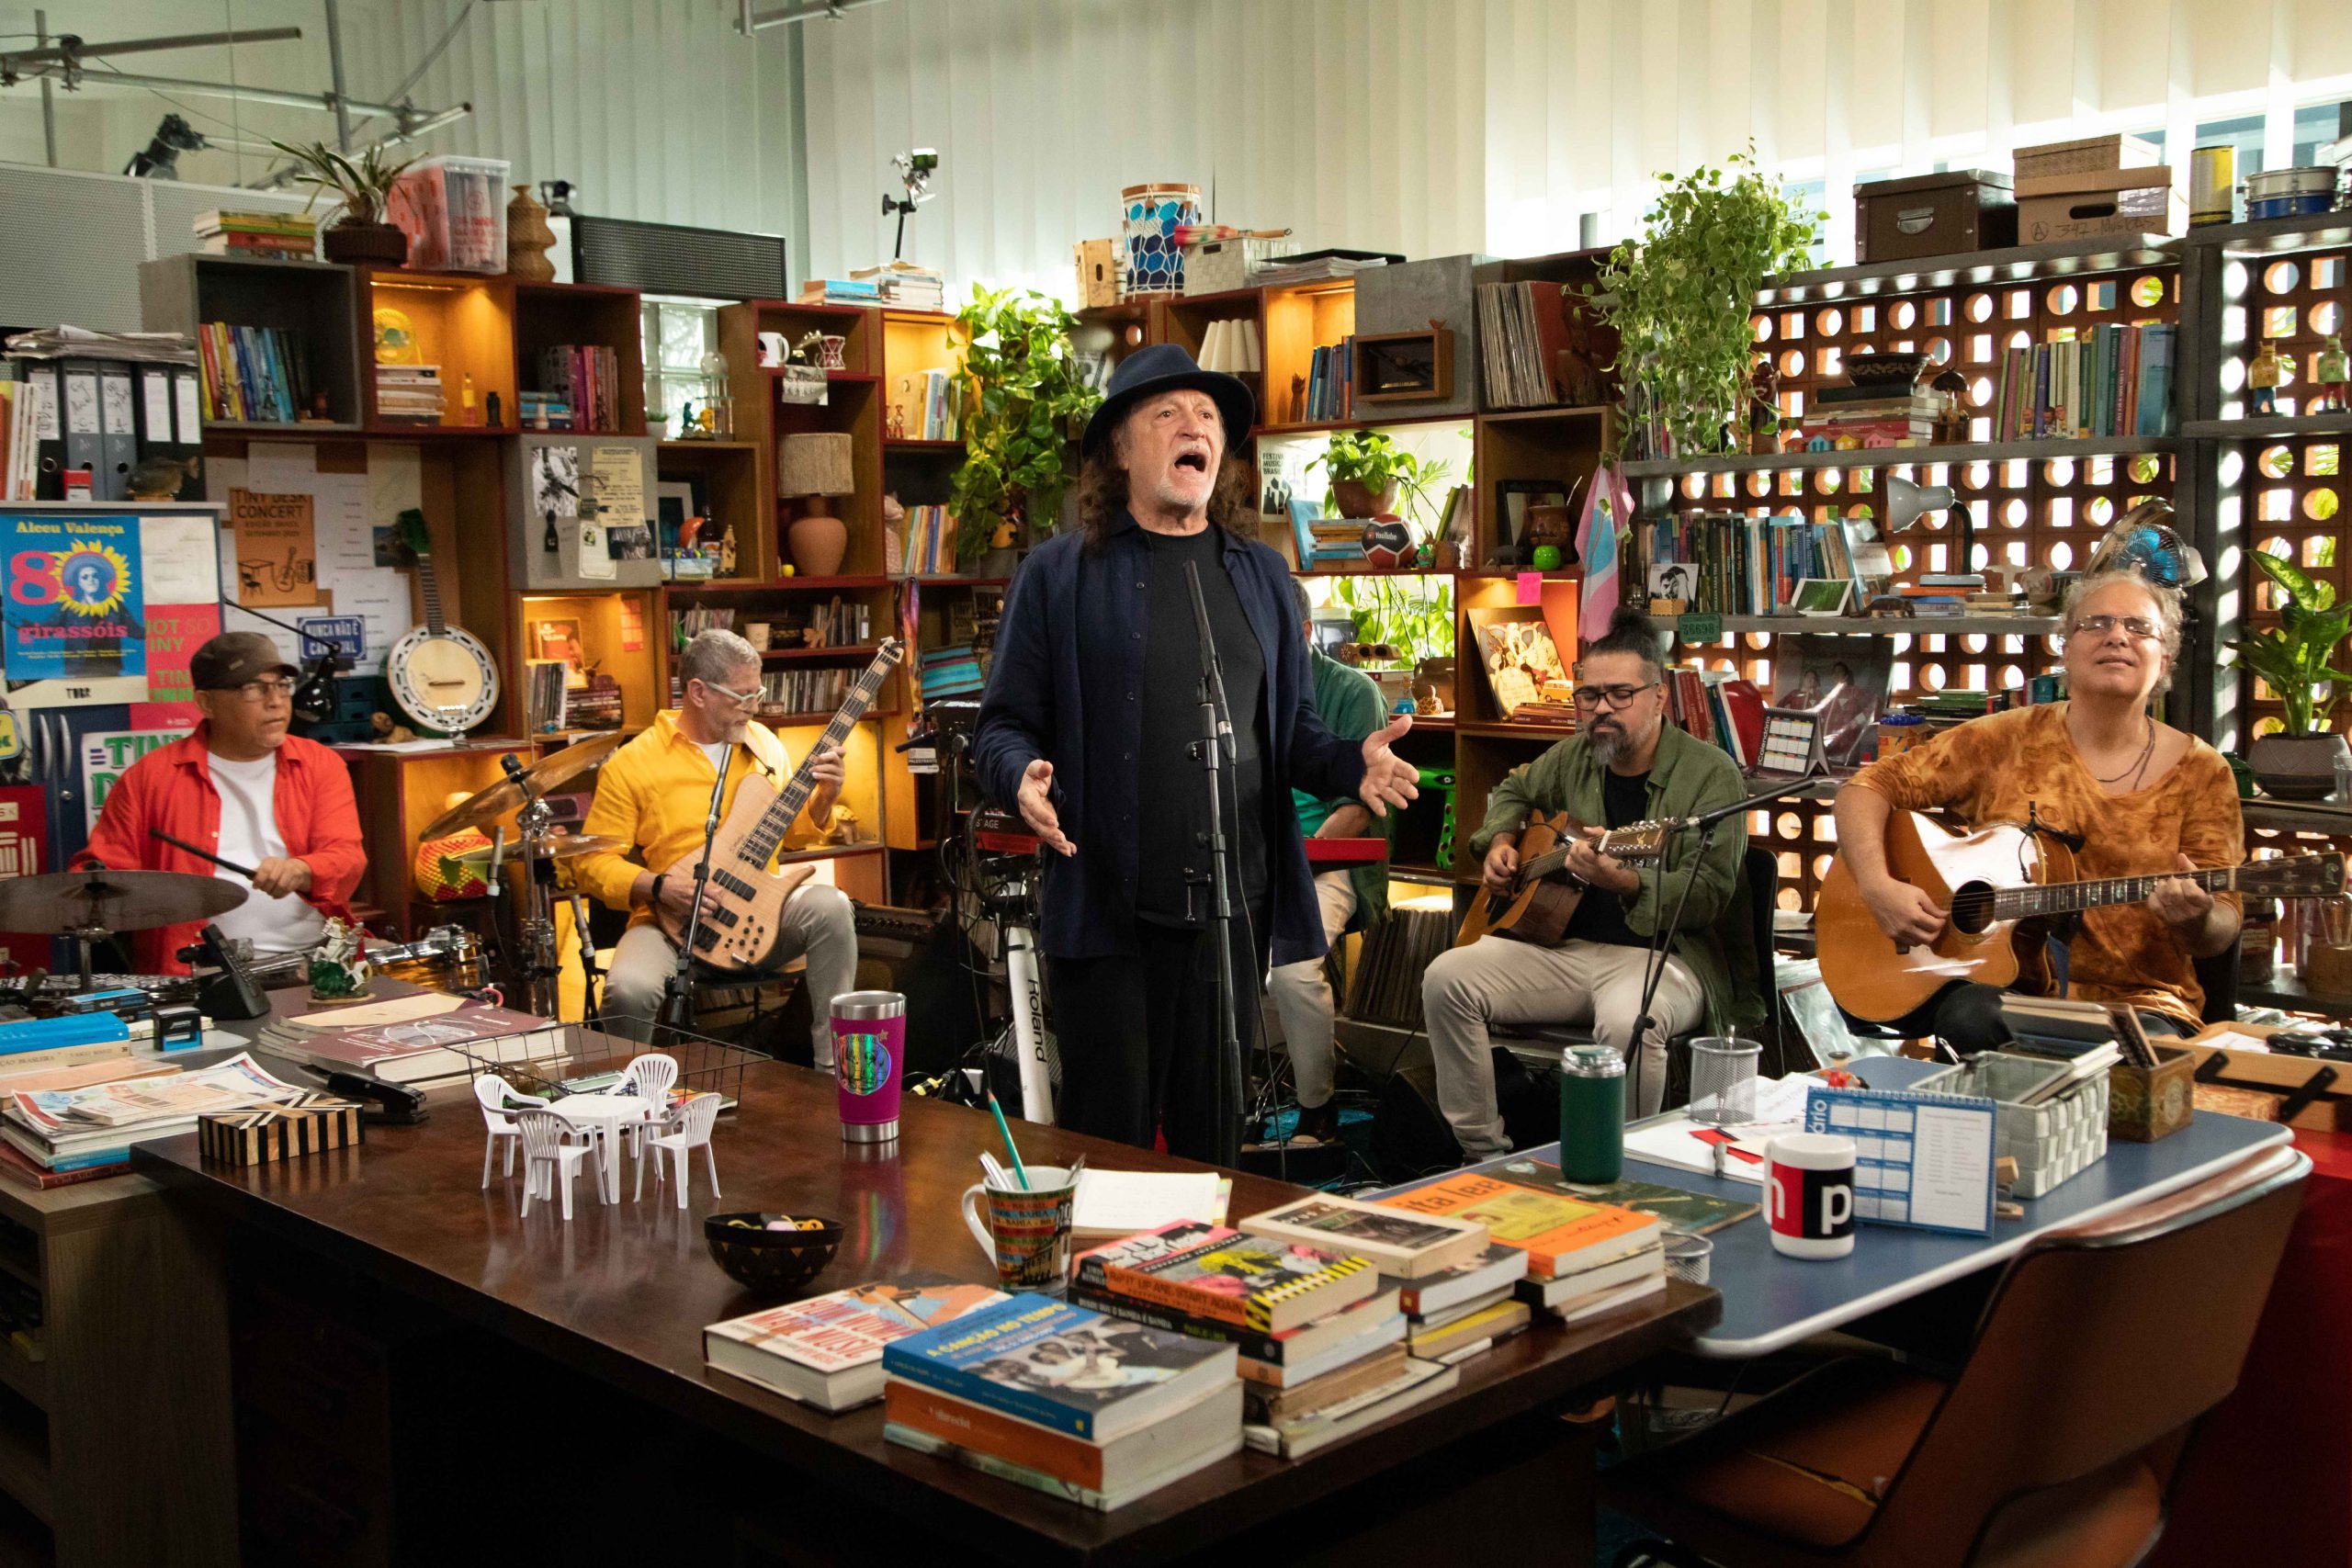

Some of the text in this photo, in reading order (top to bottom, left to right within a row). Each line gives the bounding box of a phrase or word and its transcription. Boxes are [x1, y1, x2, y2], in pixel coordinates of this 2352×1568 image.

[237, 504, 304, 519] CONCERT
[16, 521, 125, 537] Alceu Valença
[1375, 531, 1397, 541] YouTube
[17, 620, 130, 645] girassóis
[148, 637, 185, 652] INY
[156, 669, 190, 685] TIN
[1026, 978, 1047, 1064] Roland
[938, 1326, 1000, 1355] CANÇÃO
[1021, 1302, 1069, 1326] TEMPO
